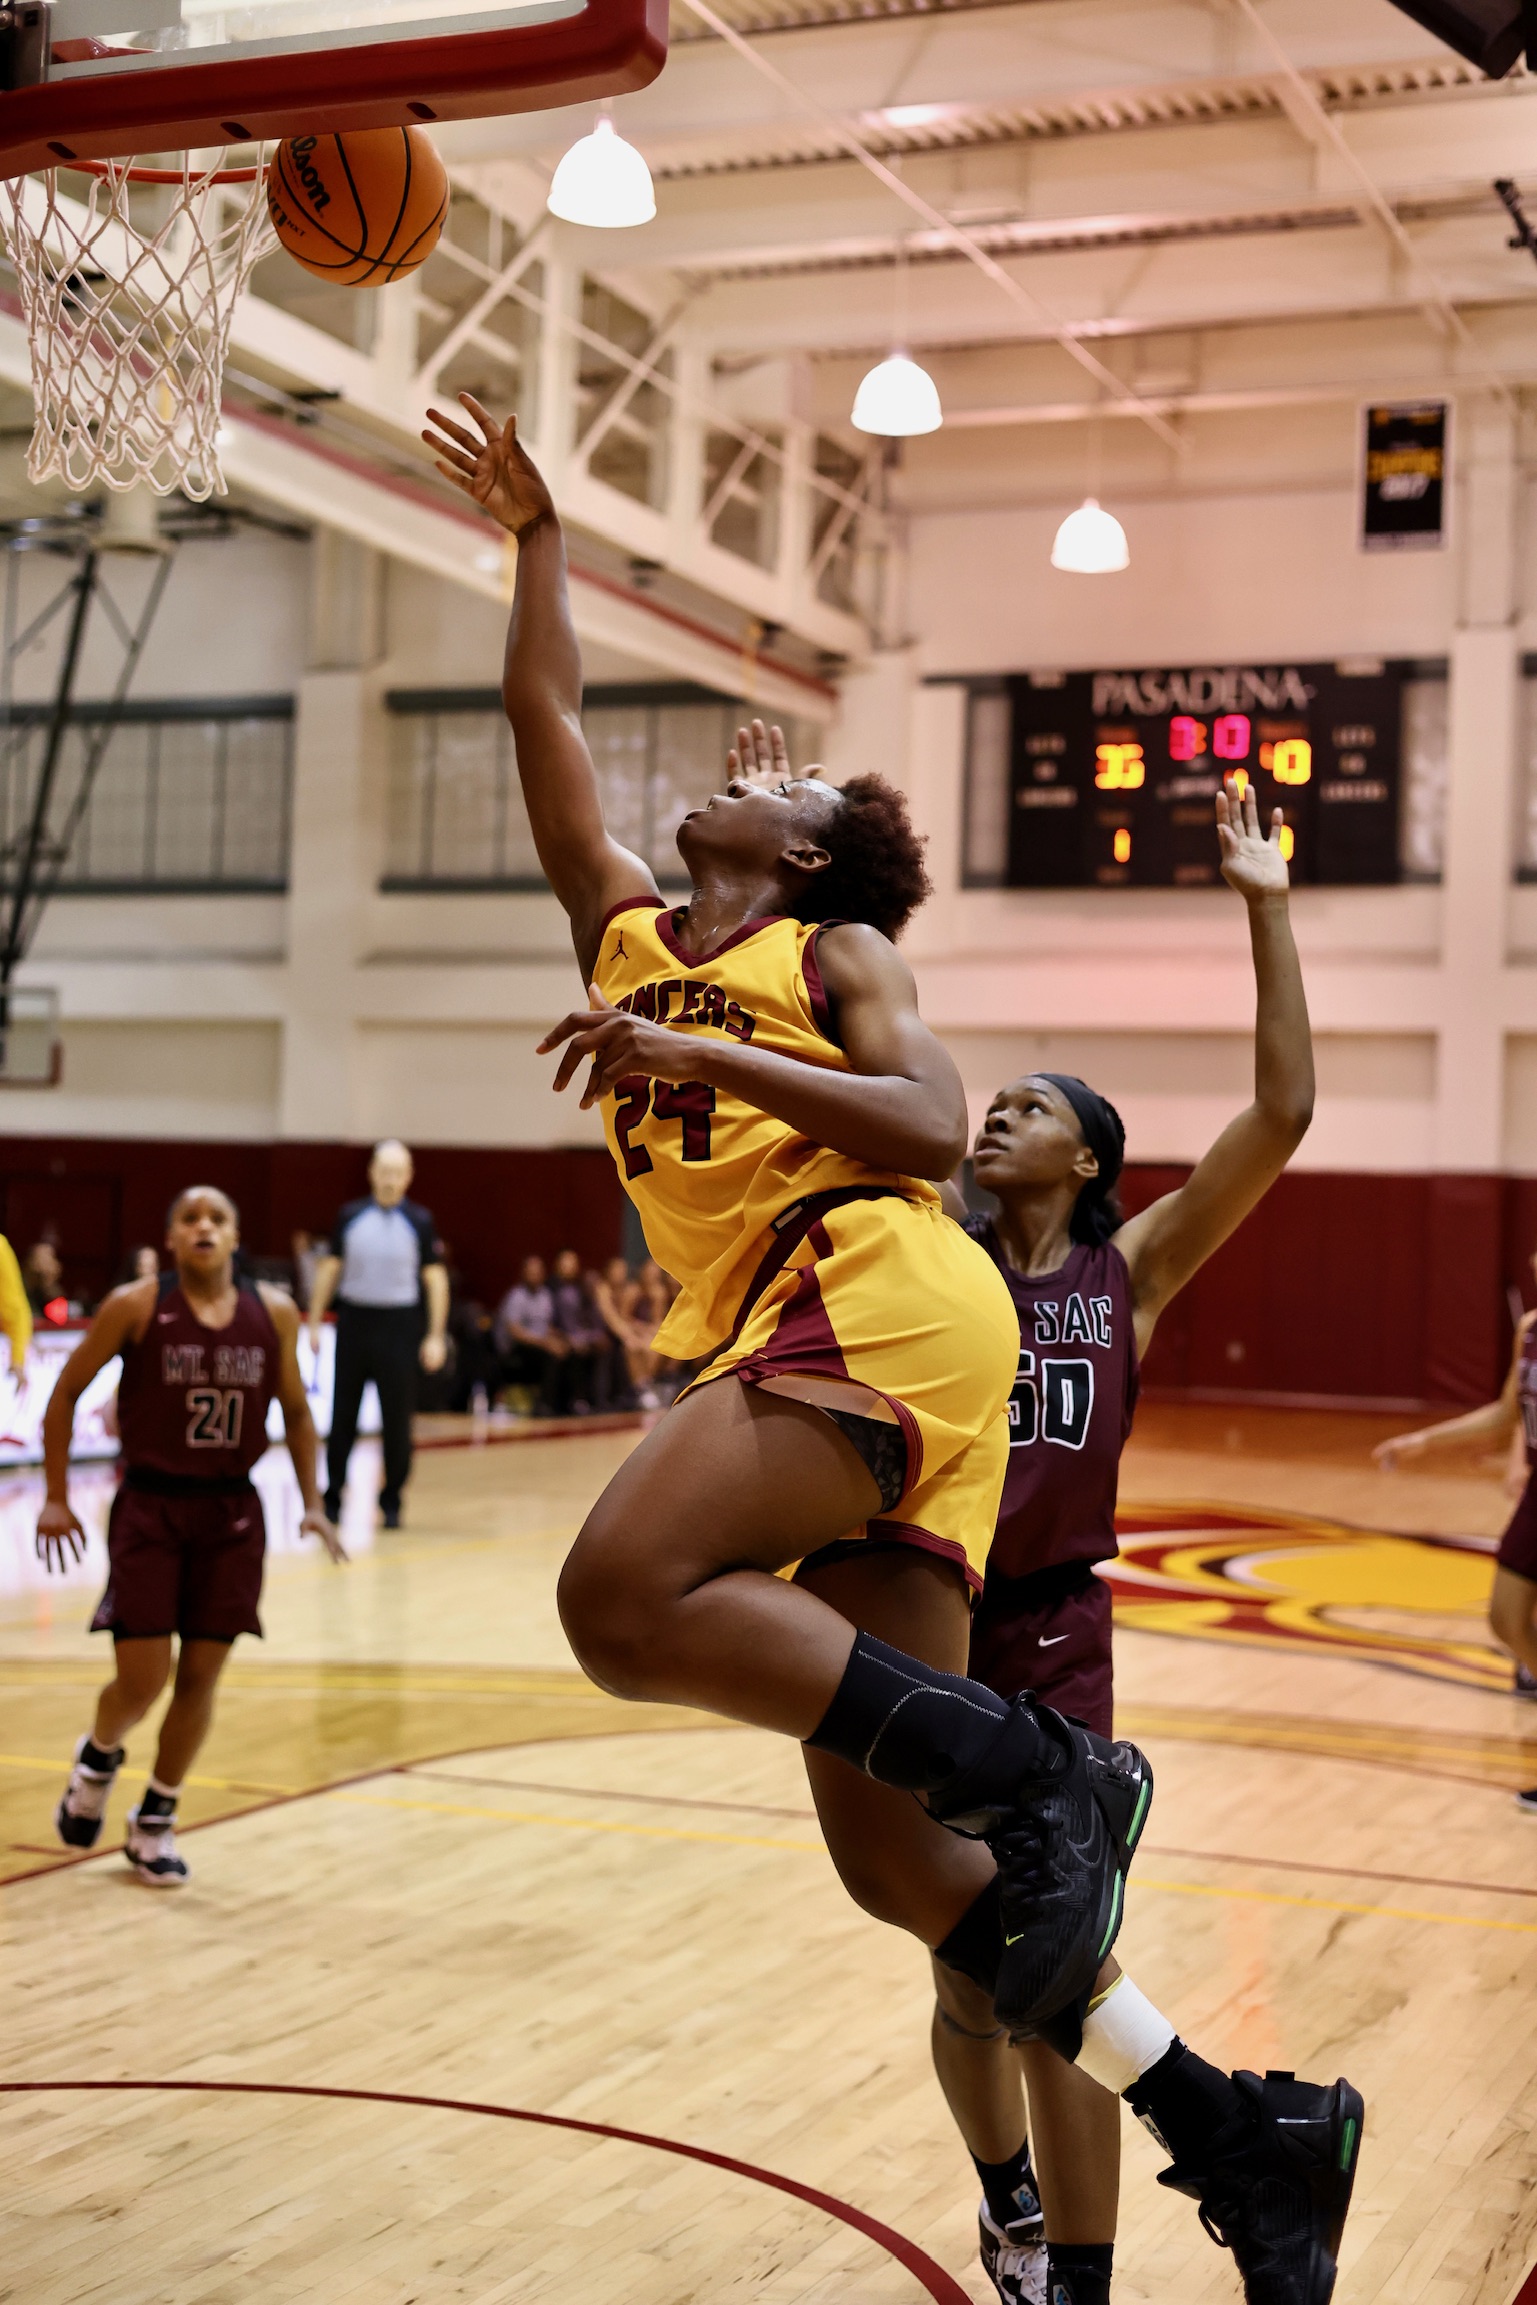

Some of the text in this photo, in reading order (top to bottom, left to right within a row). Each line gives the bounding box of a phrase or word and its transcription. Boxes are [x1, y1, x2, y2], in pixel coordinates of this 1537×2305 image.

[1091, 667, 1308, 717] PASADENA
[614, 1075, 716, 1181] 24
[1033, 1292, 1112, 1349] SAC
[185, 1387, 245, 1449] 21
[1007, 1348, 1095, 1451] 50
